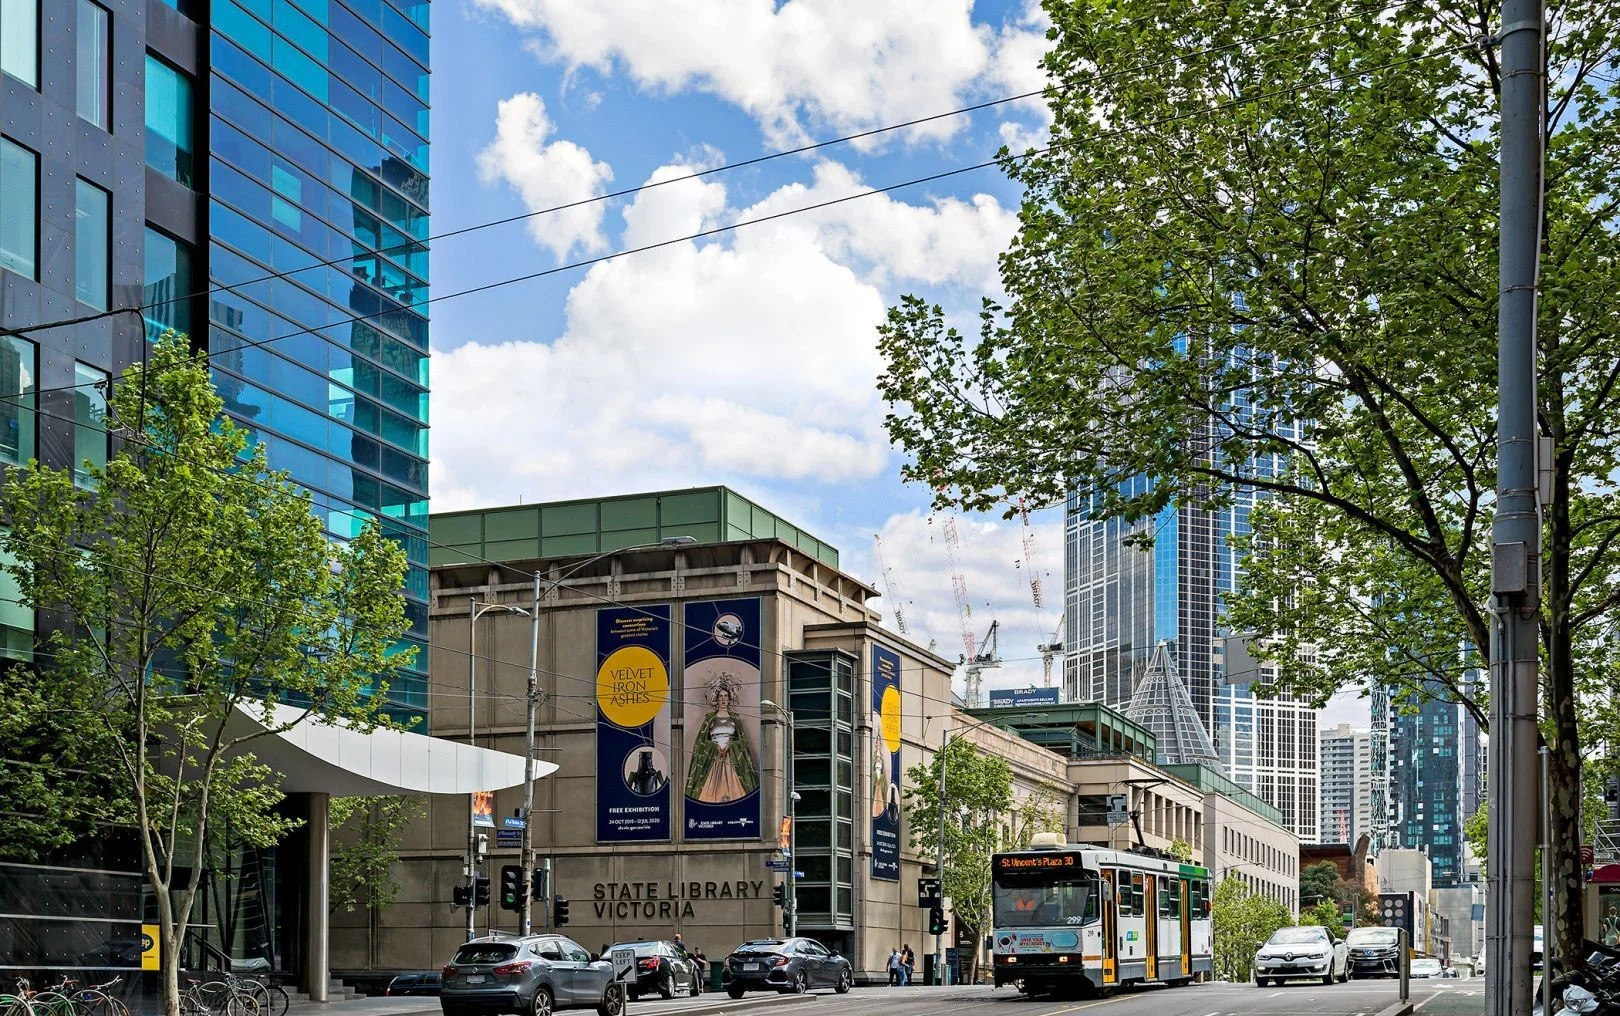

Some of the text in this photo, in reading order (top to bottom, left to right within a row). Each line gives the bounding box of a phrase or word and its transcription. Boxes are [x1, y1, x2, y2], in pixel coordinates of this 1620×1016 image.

[895, 610, 906, 635] BRADY
[610, 667, 654, 680] VELVET
[614, 681, 646, 694] IRON
[610, 693, 650, 707] ASHES
[1002, 857, 1073, 867] St Vincent's Plaza 30
[594, 881, 764, 900] STATE LIBRARY
[594, 901, 695, 918] VICTORIA
